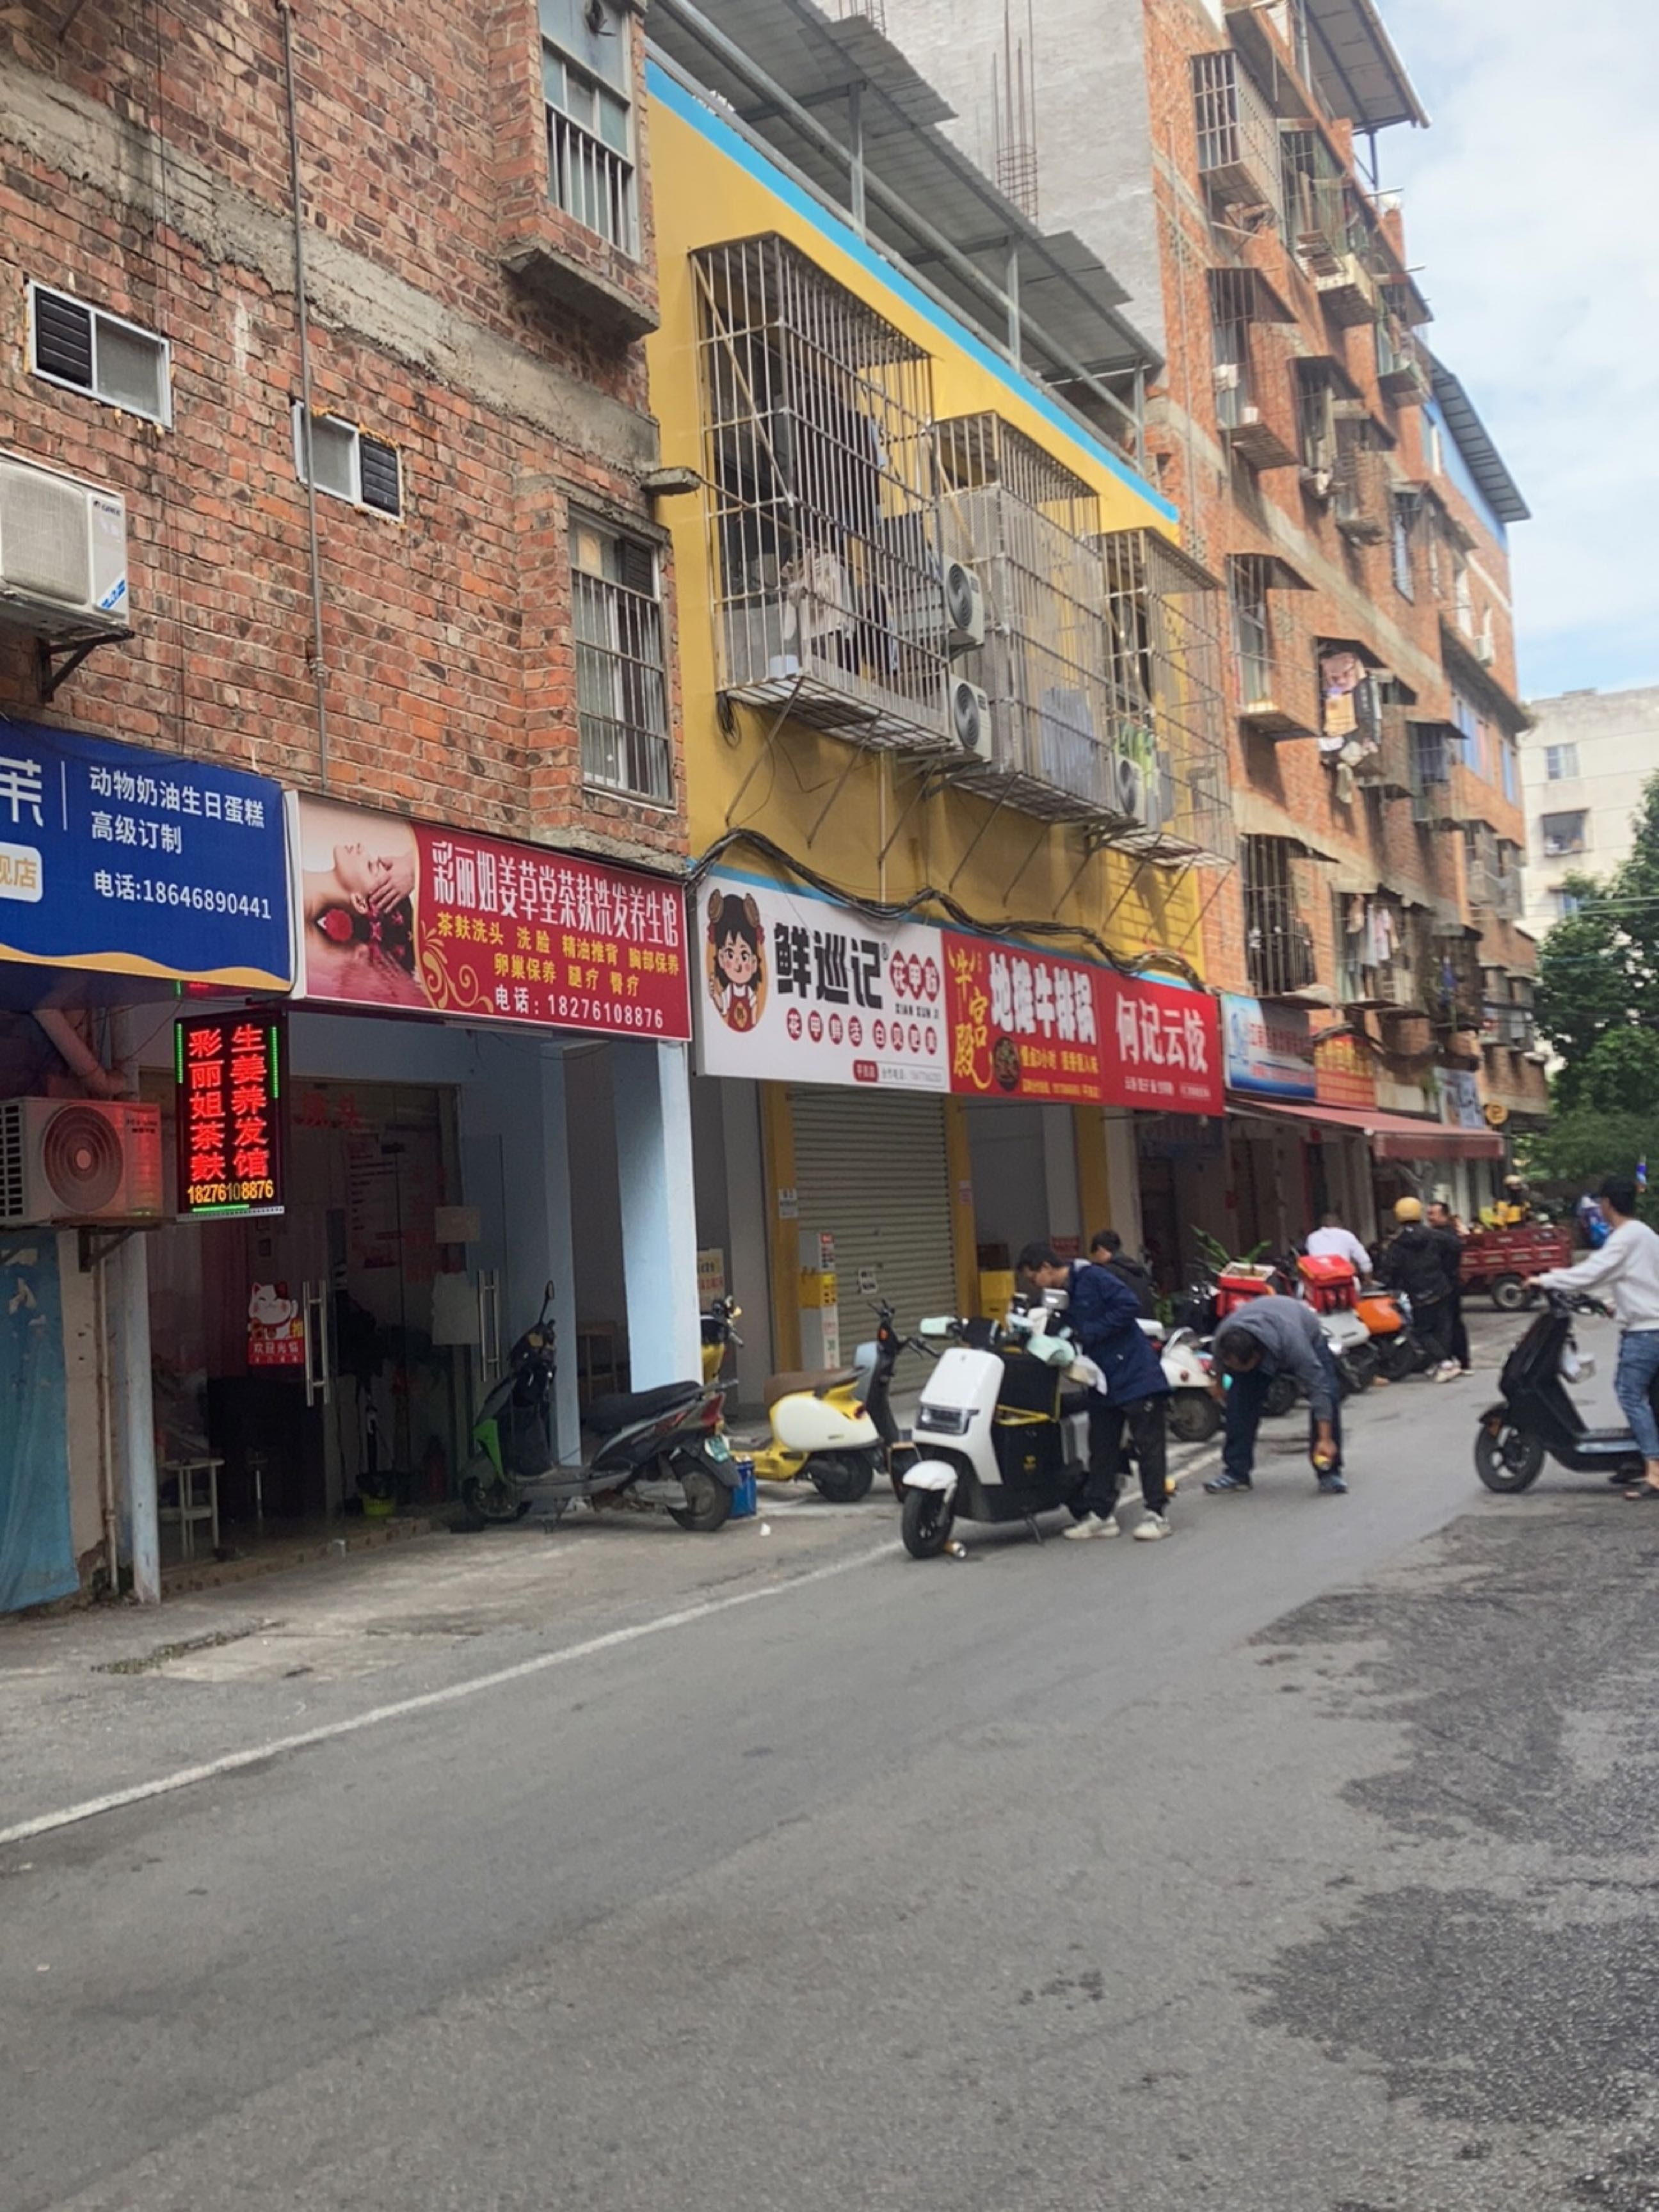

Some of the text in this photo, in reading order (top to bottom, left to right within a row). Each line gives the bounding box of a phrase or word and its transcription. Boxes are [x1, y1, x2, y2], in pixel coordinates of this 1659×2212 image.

[89, 765, 265, 829] 动物奶油生日蛋糕
[91, 810, 182, 854] 高级订制
[93, 869, 271, 919] 电话:18646890441
[432, 841, 678, 947] 彩丽姐姜草堂茶麸洗发养生馆
[437, 911, 504, 945] 茶麸洗头
[517, 926, 550, 954] 洗脸
[562, 934, 618, 966] 精油推背
[774, 922, 883, 1009] 鲜巡记
[494, 952, 557, 985] 卵巢保养
[188, 1028, 226, 1182] 彩丽姐茶麸
[230, 1023, 270, 1178] 生姜养发馆
[187, 1180, 274, 1205] 18276108876
